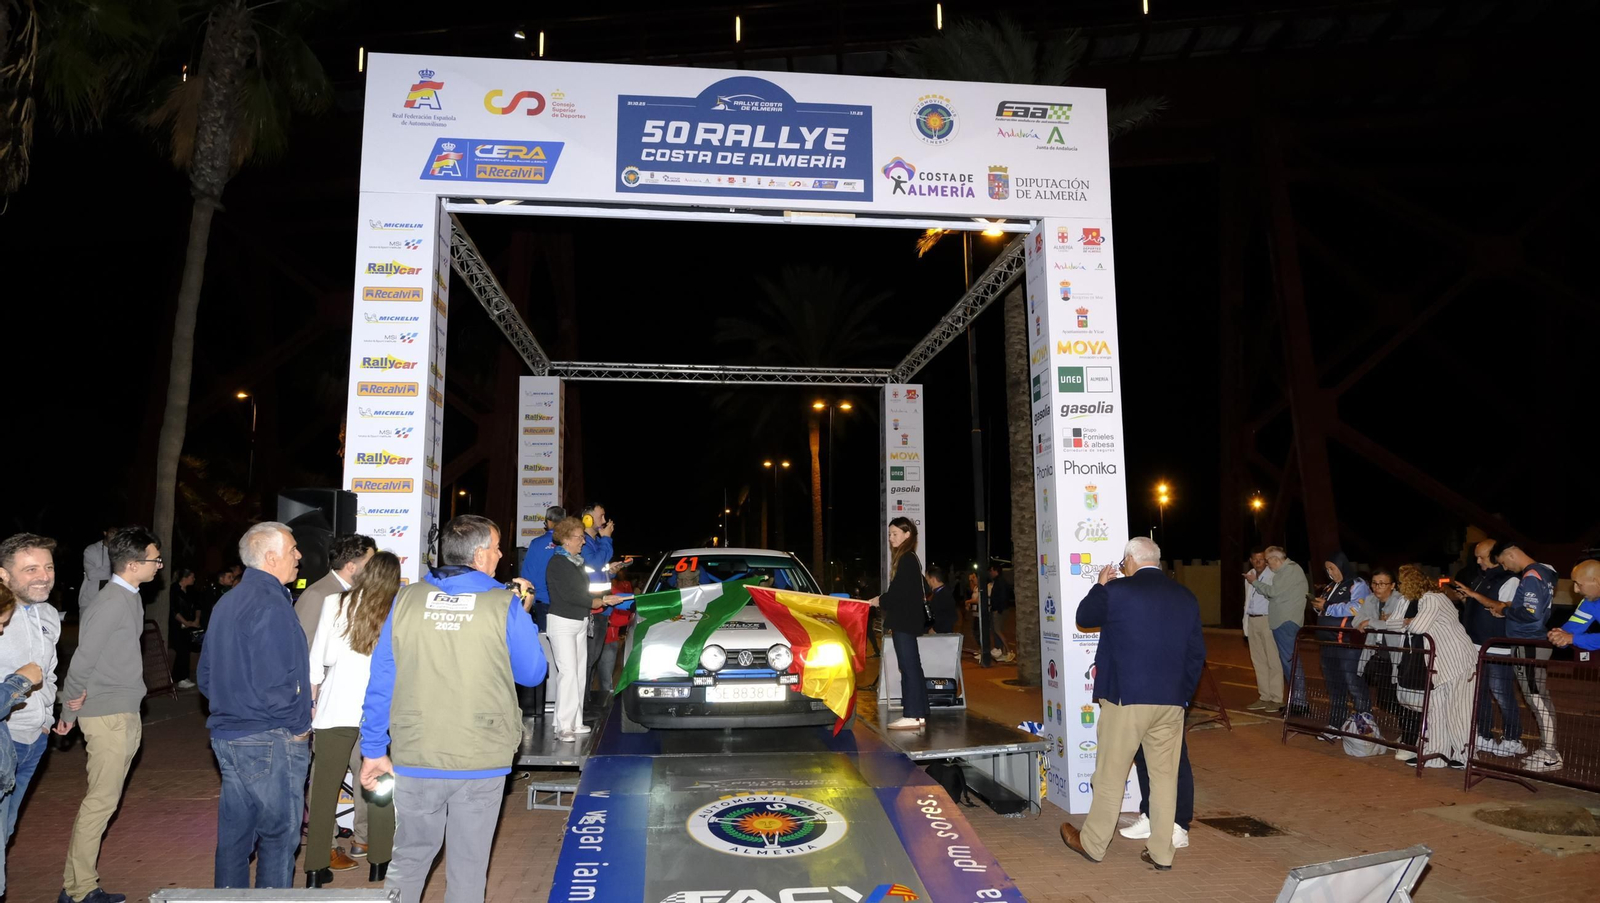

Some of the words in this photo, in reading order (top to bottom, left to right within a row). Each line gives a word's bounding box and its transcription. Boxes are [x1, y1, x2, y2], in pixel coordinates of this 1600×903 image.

[946, 104, 956, 117] CLUB
[641, 120, 690, 144] 50
[694, 122, 850, 151] RALLYE
[474, 144, 547, 160] CERA
[641, 148, 712, 164] COSTA
[716, 152, 745, 165] DE
[750, 152, 846, 169] ALMERÍA
[488, 166, 532, 178] Recalvi
[919, 172, 956, 182] COSTA
[960, 174, 974, 182] DE
[1016, 177, 1090, 190] DIPUTACIÓN
[908, 183, 976, 198] ALMERÍA
[1016, 190, 1032, 199] DE
[1034, 190, 1088, 201] ALMERÍA
[368, 262, 422, 275] Rallycar
[374, 289, 411, 299] Recalvi
[1056, 340, 1112, 355] MOYA
[362, 357, 418, 369] Rallycar
[1060, 376, 1082, 384] UNED
[369, 384, 407, 394] Recalvi
[1060, 401, 1114, 417] gasolia
[356, 452, 413, 465] Rallycar
[1064, 460, 1117, 474] Phonika
[364, 480, 402, 490] Recalvi
[891, 485, 920, 494] gasolia
[675, 557, 699, 572] 61
[423, 612, 474, 622] FOTO/TV
[435, 622, 460, 630] 2025
[733, 687, 764, 699] 8838
[699, 796, 787, 819] AUTOMOVIL
[798, 800, 833, 817] CLUB
[729, 844, 818, 855] ALMERIA
